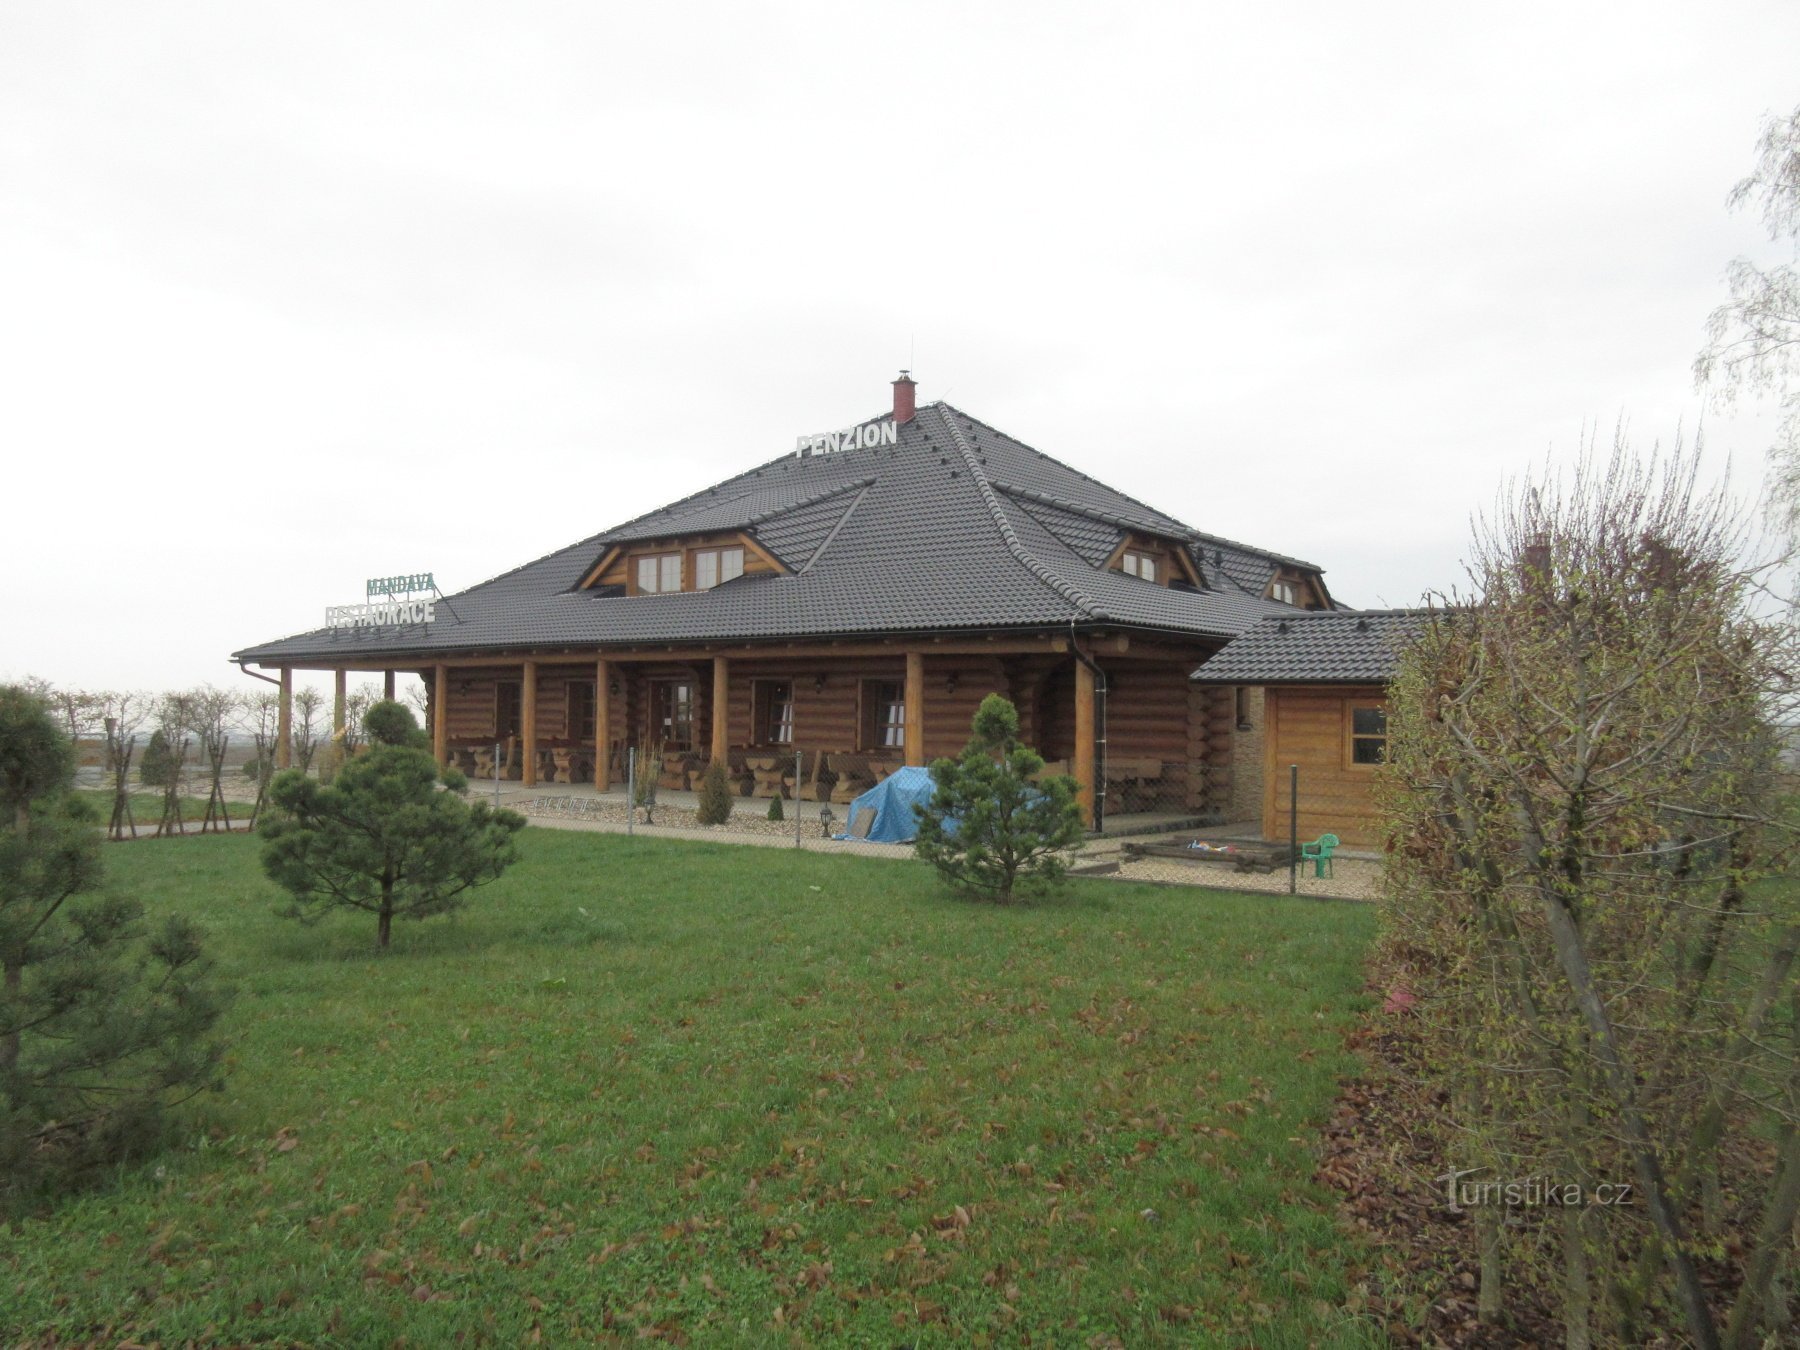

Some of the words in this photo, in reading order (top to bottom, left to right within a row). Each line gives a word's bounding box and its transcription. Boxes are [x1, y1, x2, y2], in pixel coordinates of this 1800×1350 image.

[796, 421, 897, 458] PENZION
[367, 573, 434, 596] MANDAVA
[325, 598, 436, 629] RESTAURACE
